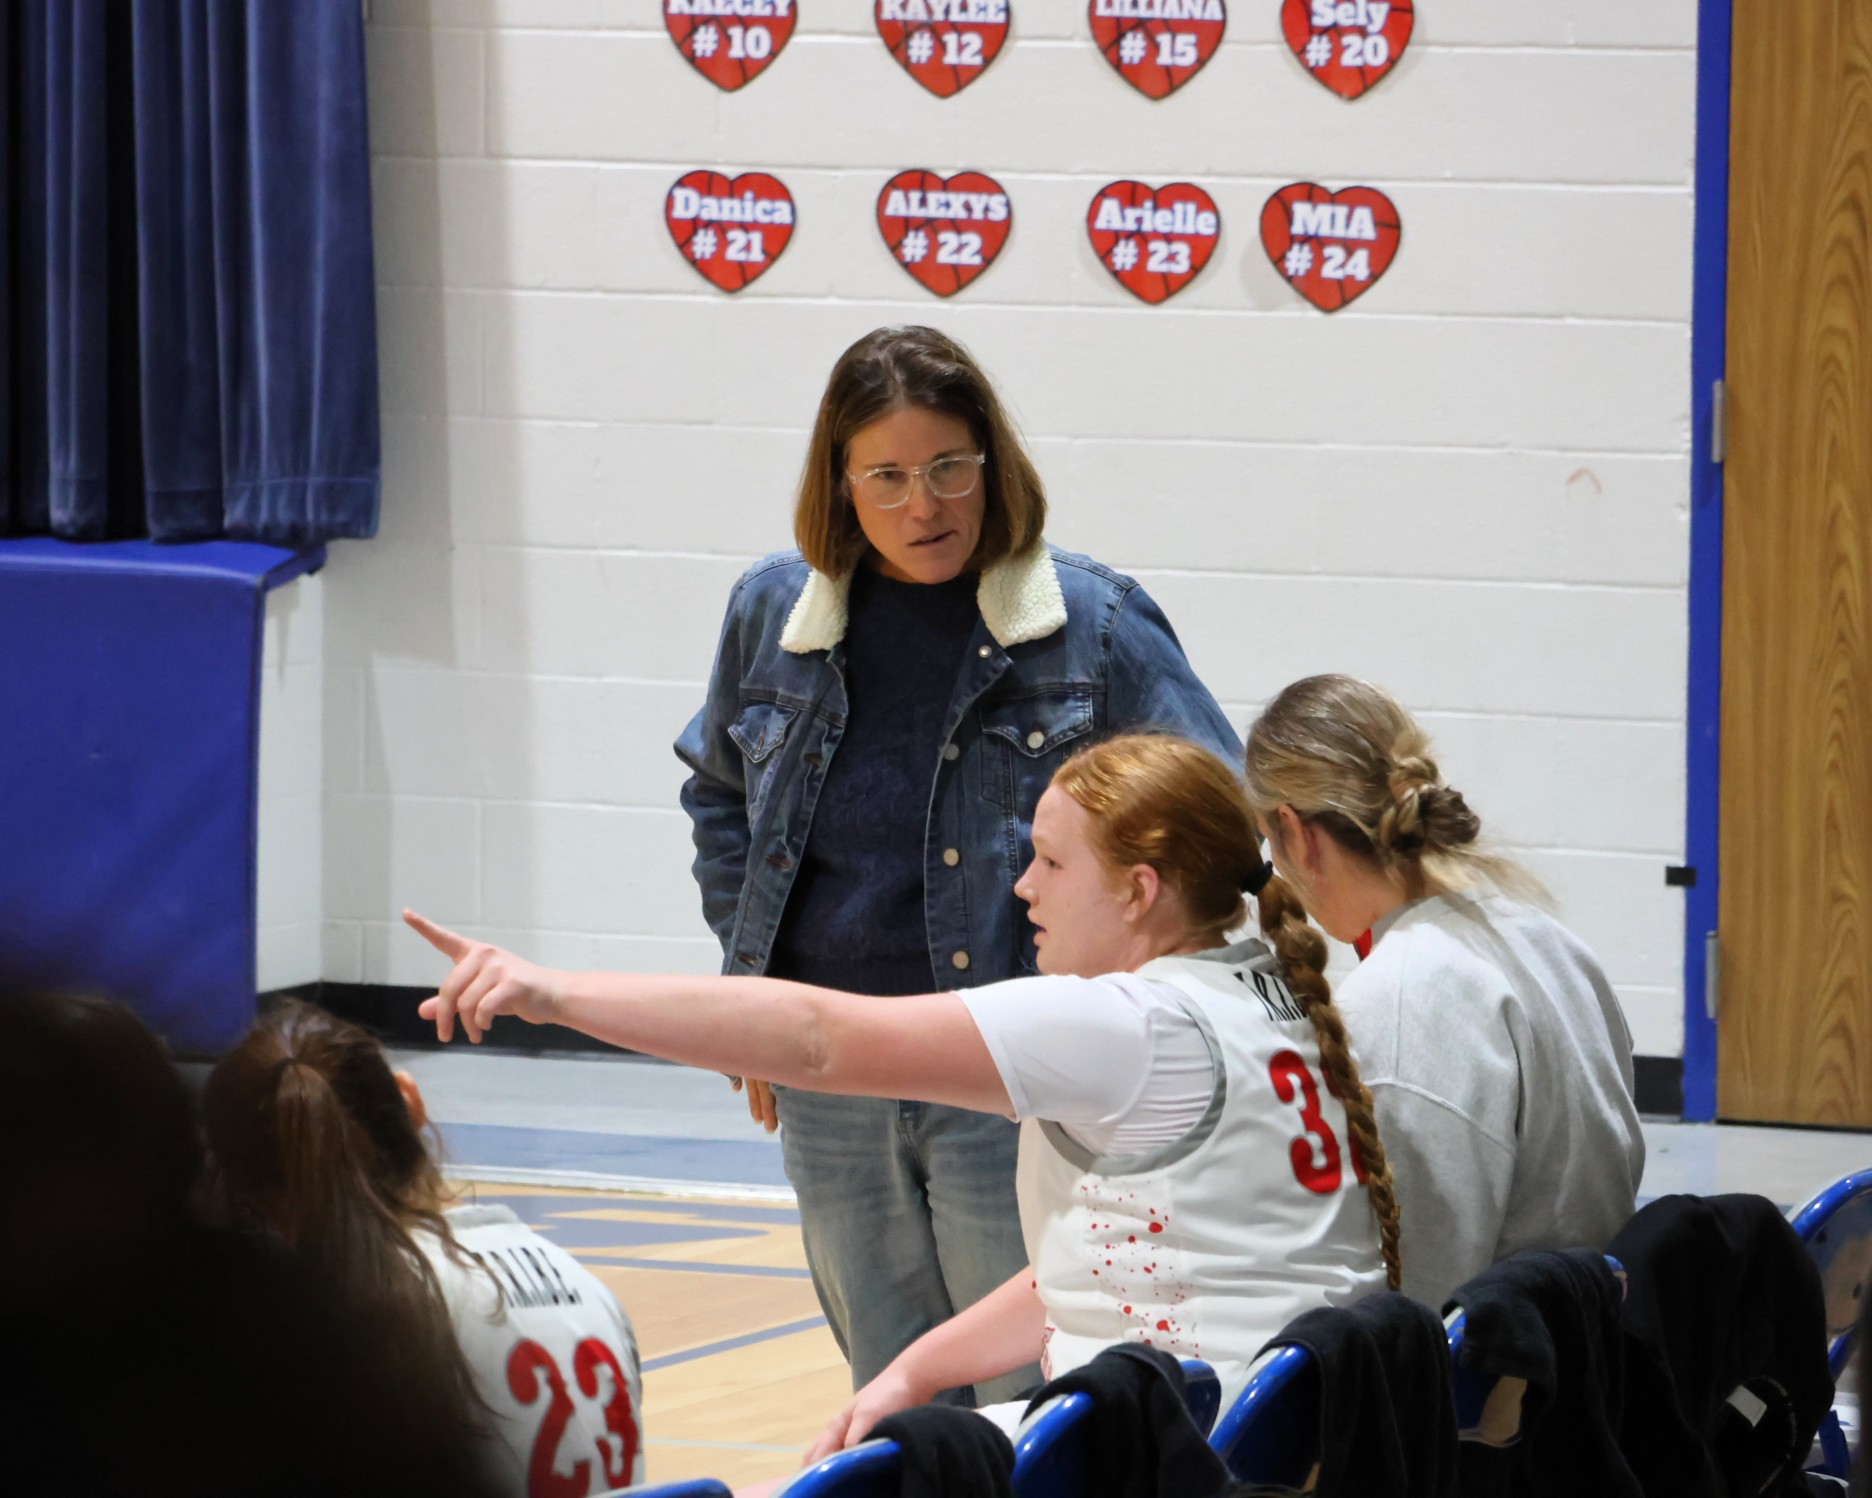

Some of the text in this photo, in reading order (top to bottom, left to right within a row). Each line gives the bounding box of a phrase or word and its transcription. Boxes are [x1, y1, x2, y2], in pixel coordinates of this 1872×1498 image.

[880, 0, 1008, 24] KAYLEE
[692, 25, 772, 59] # 10
[907, 32, 984, 66] # 12
[1119, 32, 1198, 67] # 15
[1305, 34, 1389, 67] # 20
[671, 188, 794, 224] Danica
[884, 190, 1010, 220] ALEXYS
[1094, 198, 1218, 235] Arielle
[1290, 202, 1378, 240] MIA
[691, 228, 766, 262] # 21
[902, 230, 983, 265] # 22
[1111, 239, 1192, 274] # 23
[1284, 243, 1371, 281] # 24
[505, 1336, 640, 1498] 23
